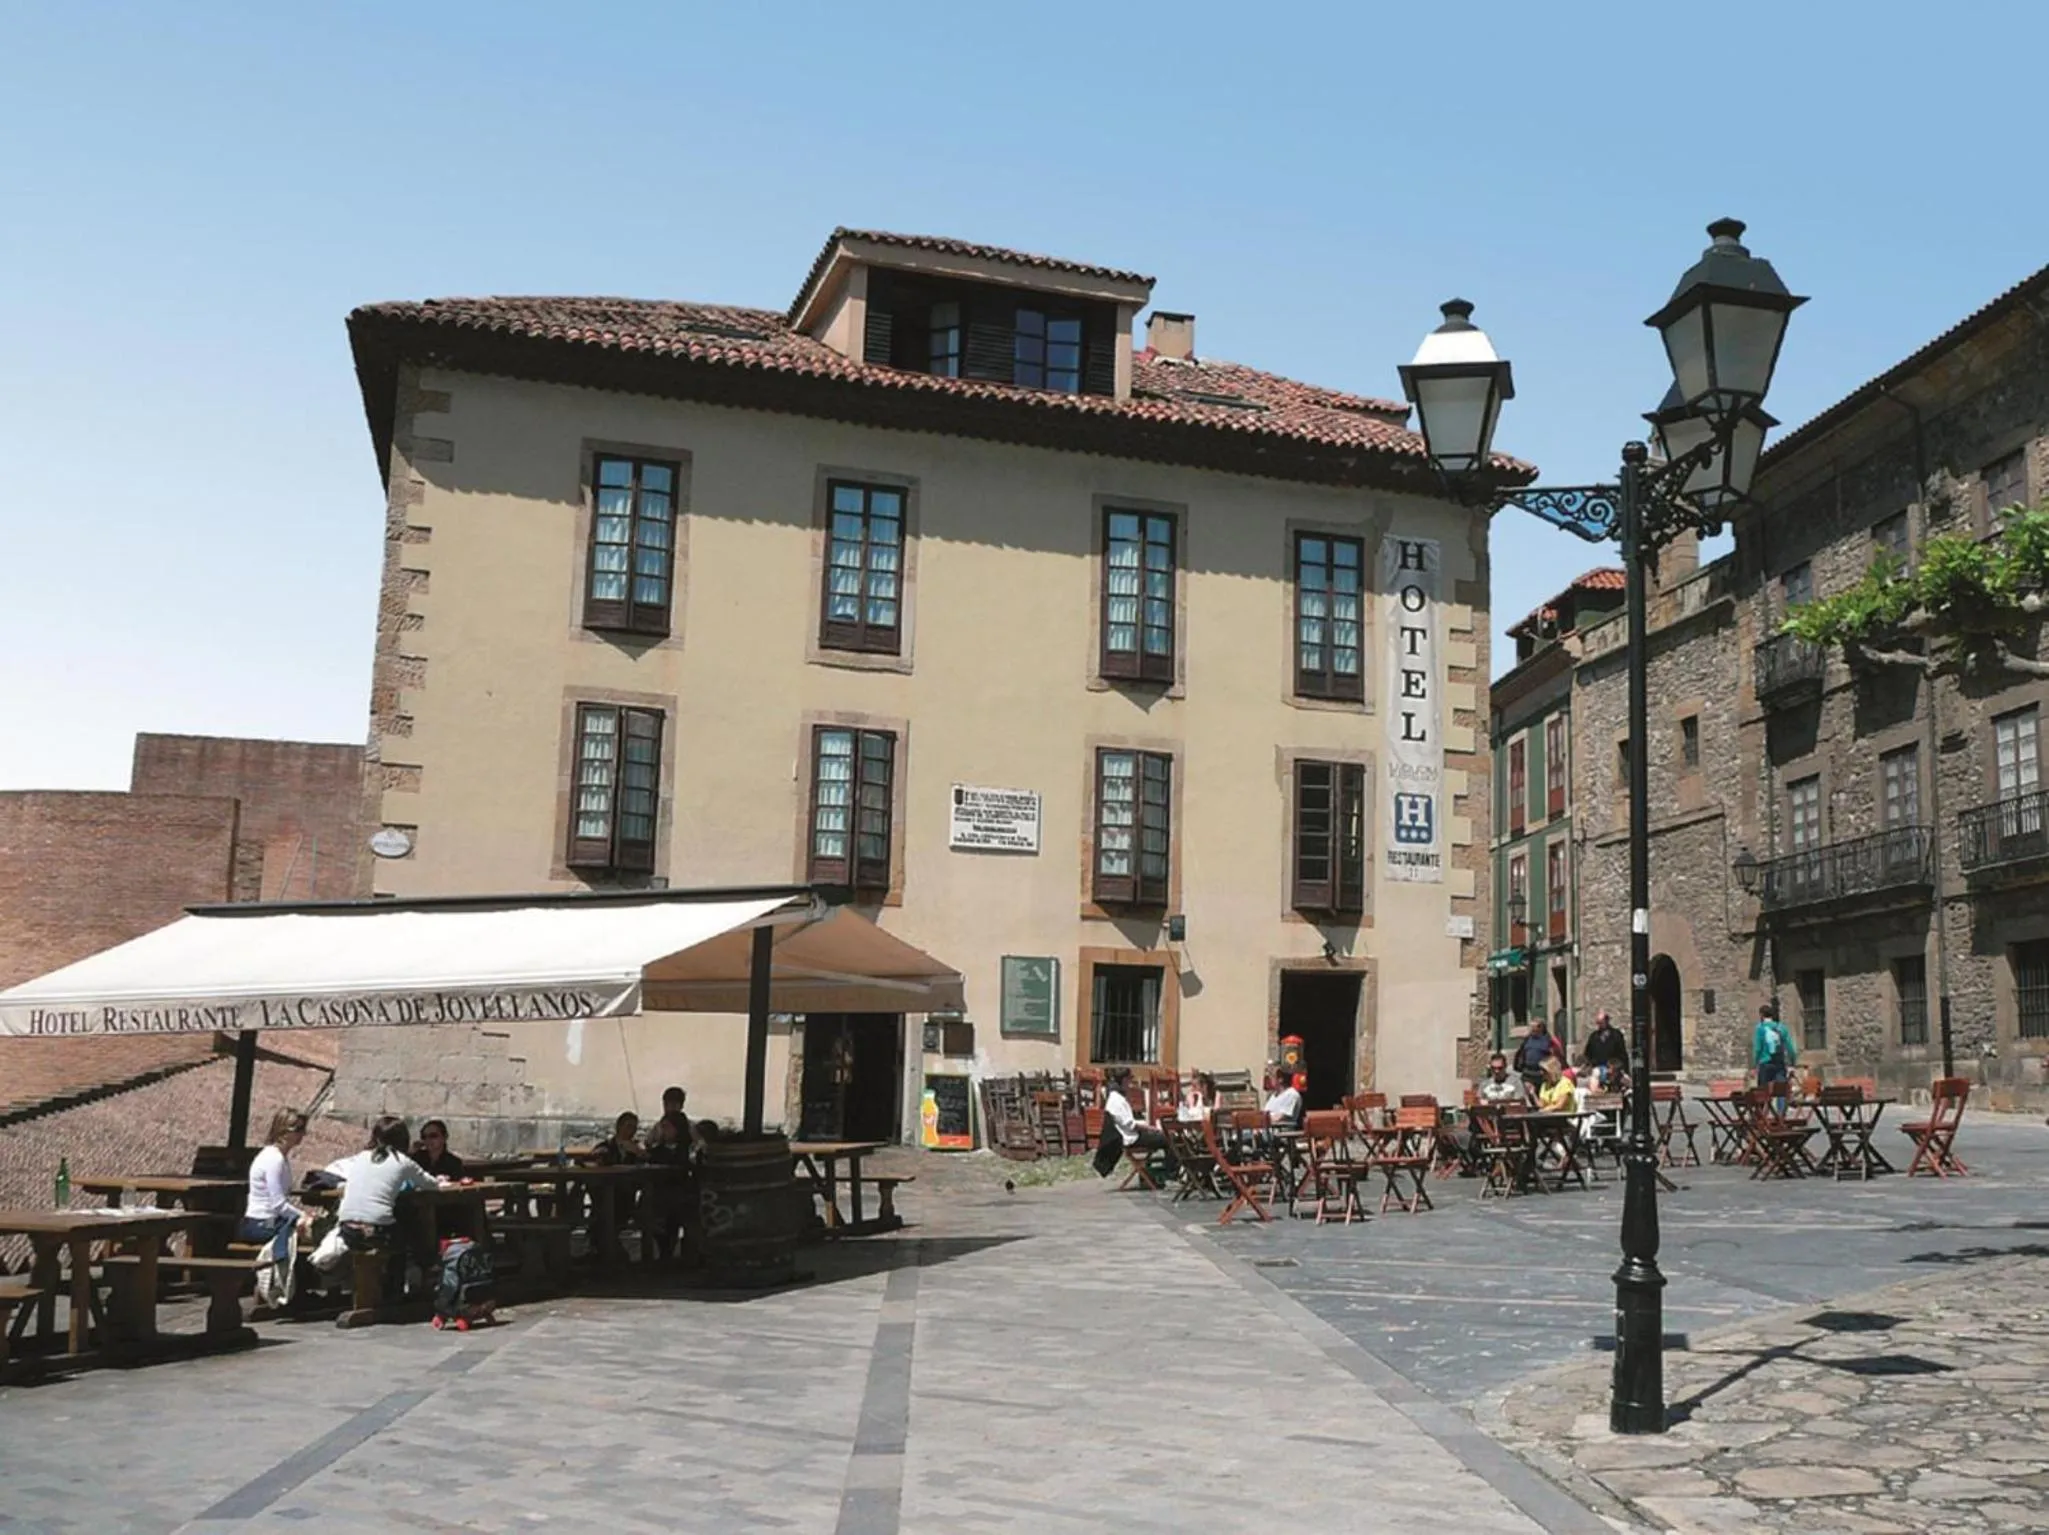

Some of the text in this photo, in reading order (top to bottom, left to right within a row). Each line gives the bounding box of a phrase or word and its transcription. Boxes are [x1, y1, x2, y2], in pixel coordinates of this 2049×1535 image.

[1399, 540, 1427, 742] HOTEL
[1398, 795, 1429, 827] H
[1388, 850, 1440, 867] RESTAURANTE
[30, 992, 595, 1034] HOTEL RESTAURANTE LA CASONA DE JOVELLANOS
